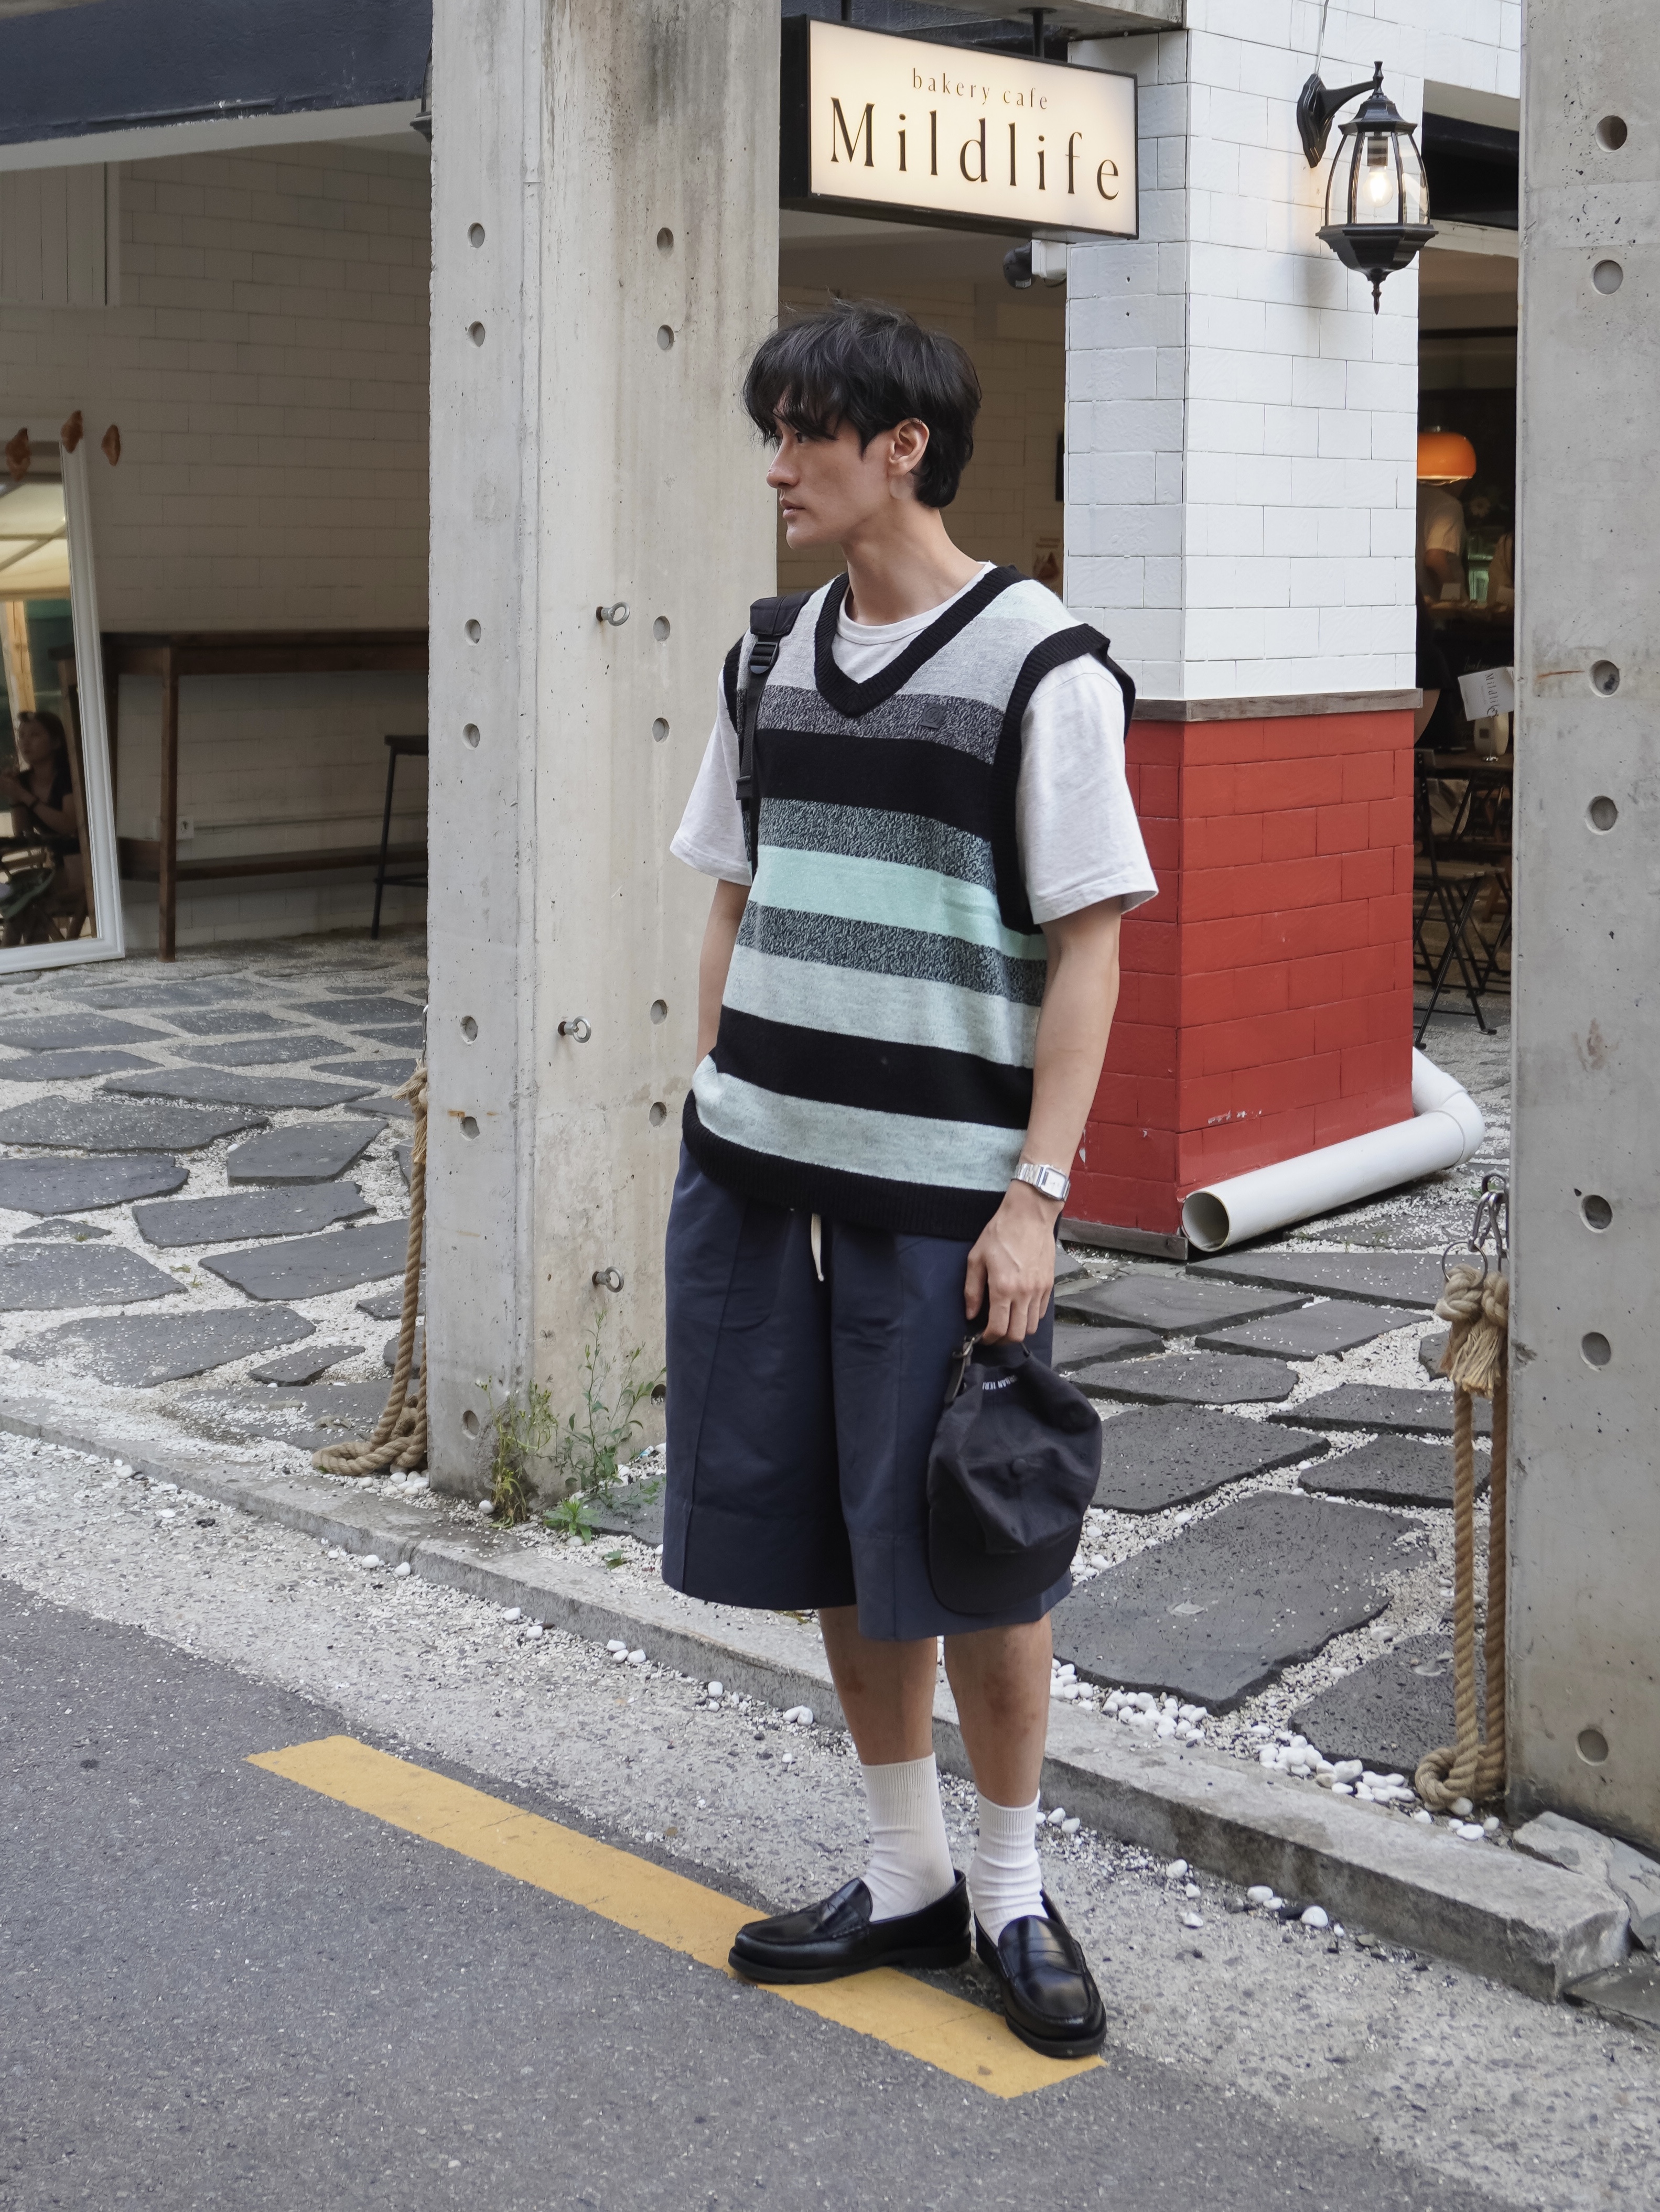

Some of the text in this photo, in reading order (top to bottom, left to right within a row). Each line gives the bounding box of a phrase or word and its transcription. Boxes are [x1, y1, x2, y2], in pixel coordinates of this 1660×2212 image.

[913, 68, 1048, 110] bakery cafe
[831, 97, 1119, 200] Mildlife
